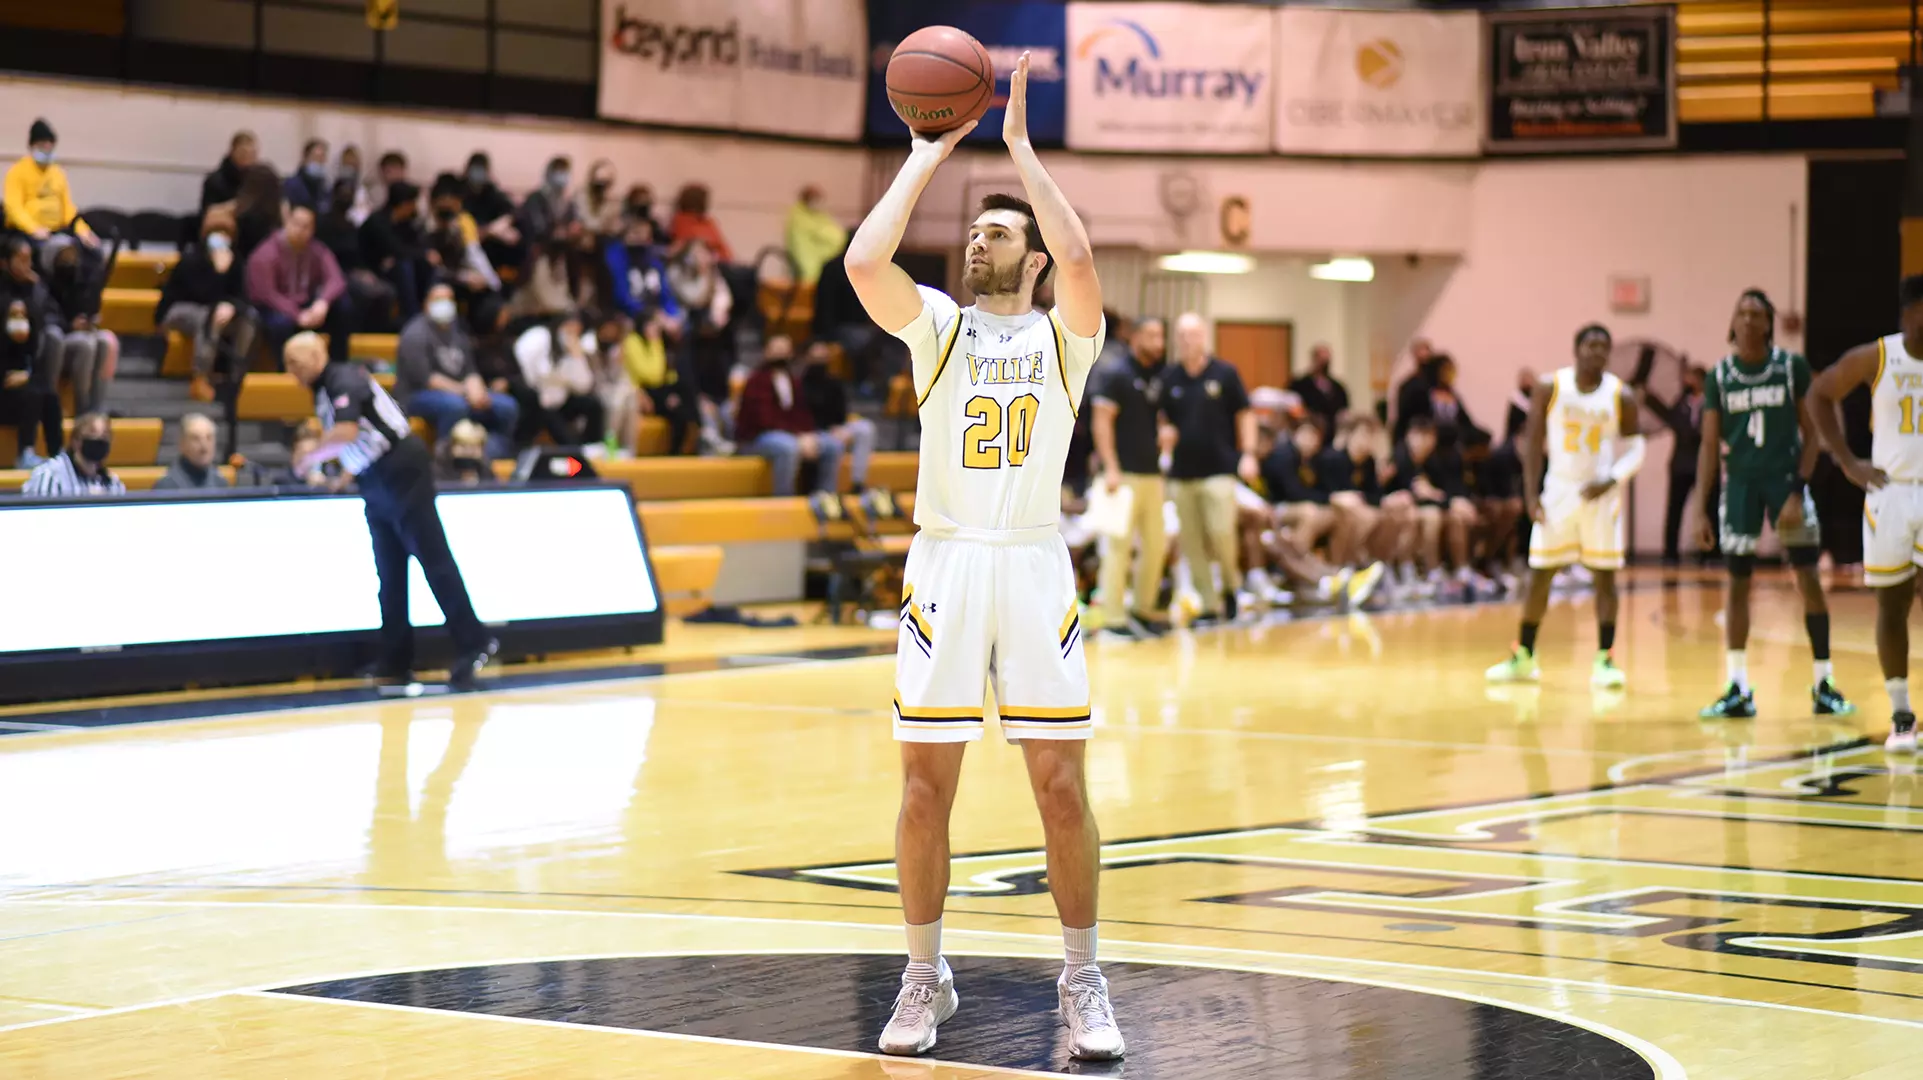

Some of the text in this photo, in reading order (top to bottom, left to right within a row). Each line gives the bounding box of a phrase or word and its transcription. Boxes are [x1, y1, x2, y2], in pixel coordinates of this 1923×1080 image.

[613, 4, 740, 71] beyond
[1094, 58, 1263, 109] Murray
[1219, 196, 1250, 247] C
[965, 351, 1045, 386] VILLE
[962, 392, 1040, 469] 20
[1747, 409, 1765, 448] 4
[1899, 394, 1923, 435] 1
